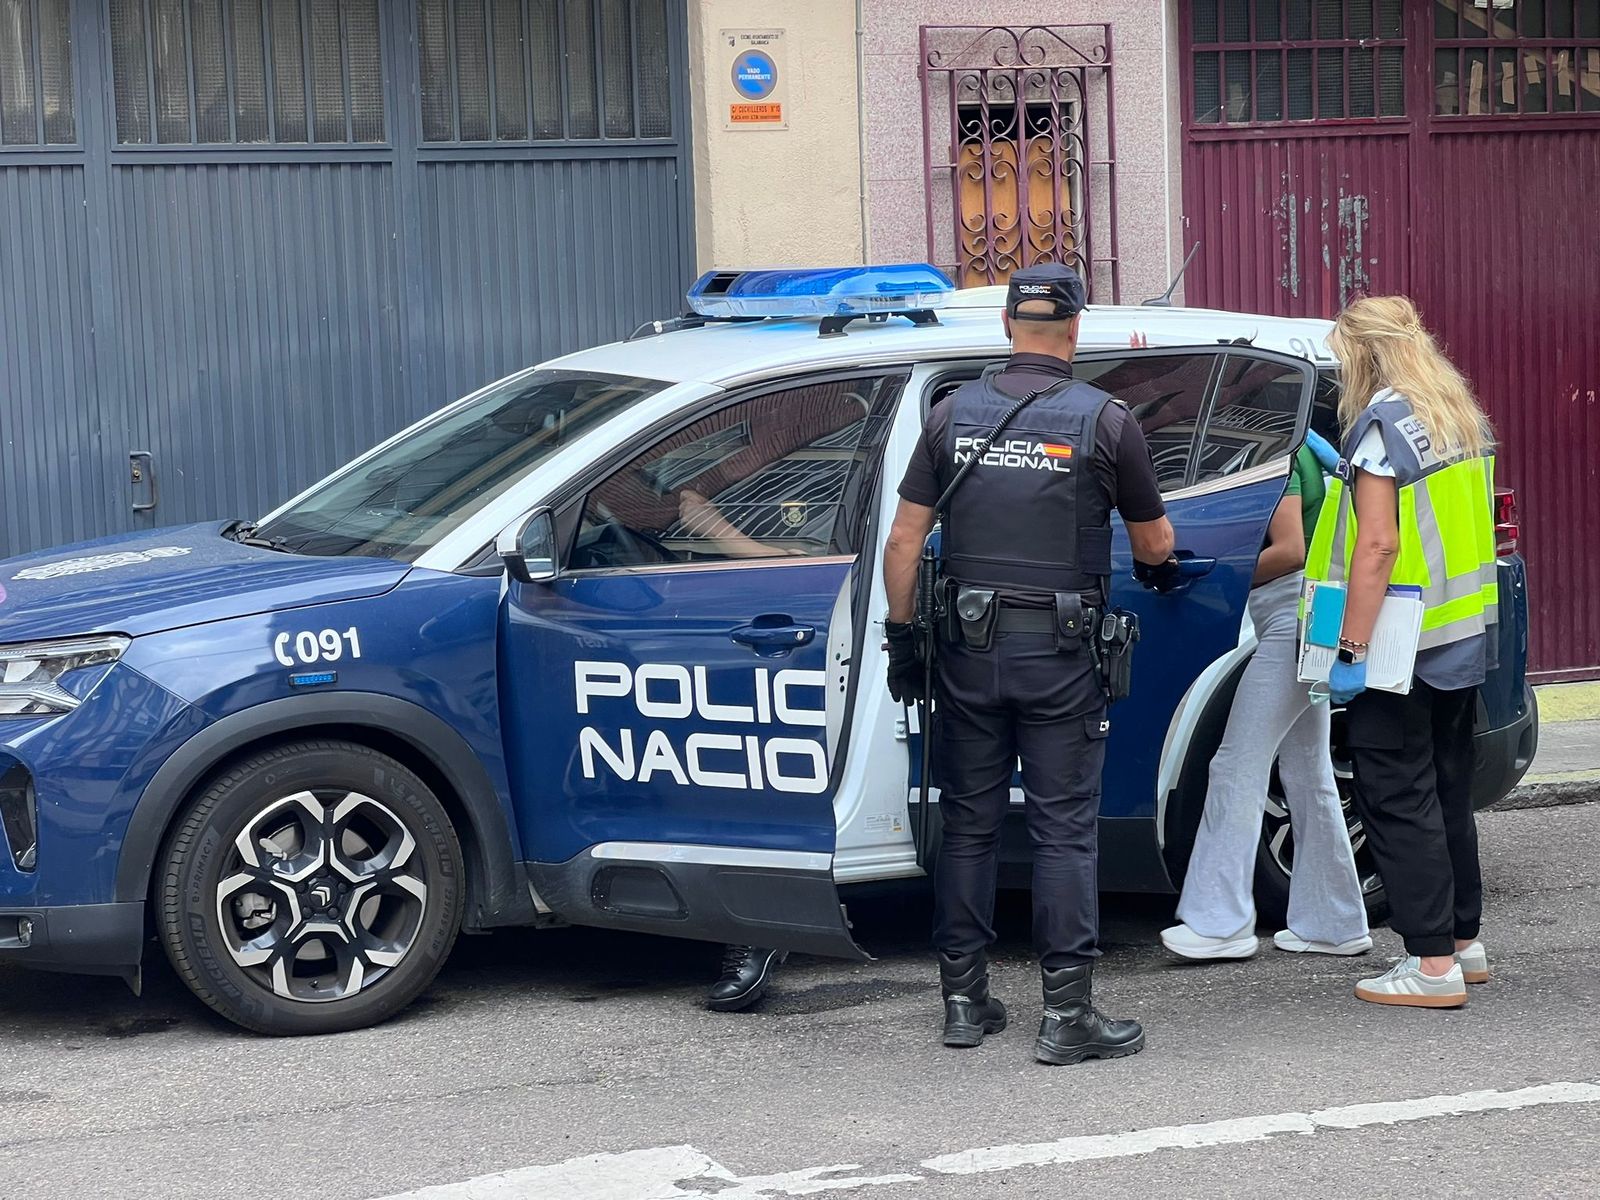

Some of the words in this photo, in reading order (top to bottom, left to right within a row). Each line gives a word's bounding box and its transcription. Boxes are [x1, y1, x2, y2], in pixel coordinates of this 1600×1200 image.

[295, 626, 361, 664] 091
[574, 660, 827, 727] POLIC
[579, 726, 829, 794] NACIO
[405, 792, 453, 876] MICHELIN
[188, 913, 244, 1000] MICHELIN
